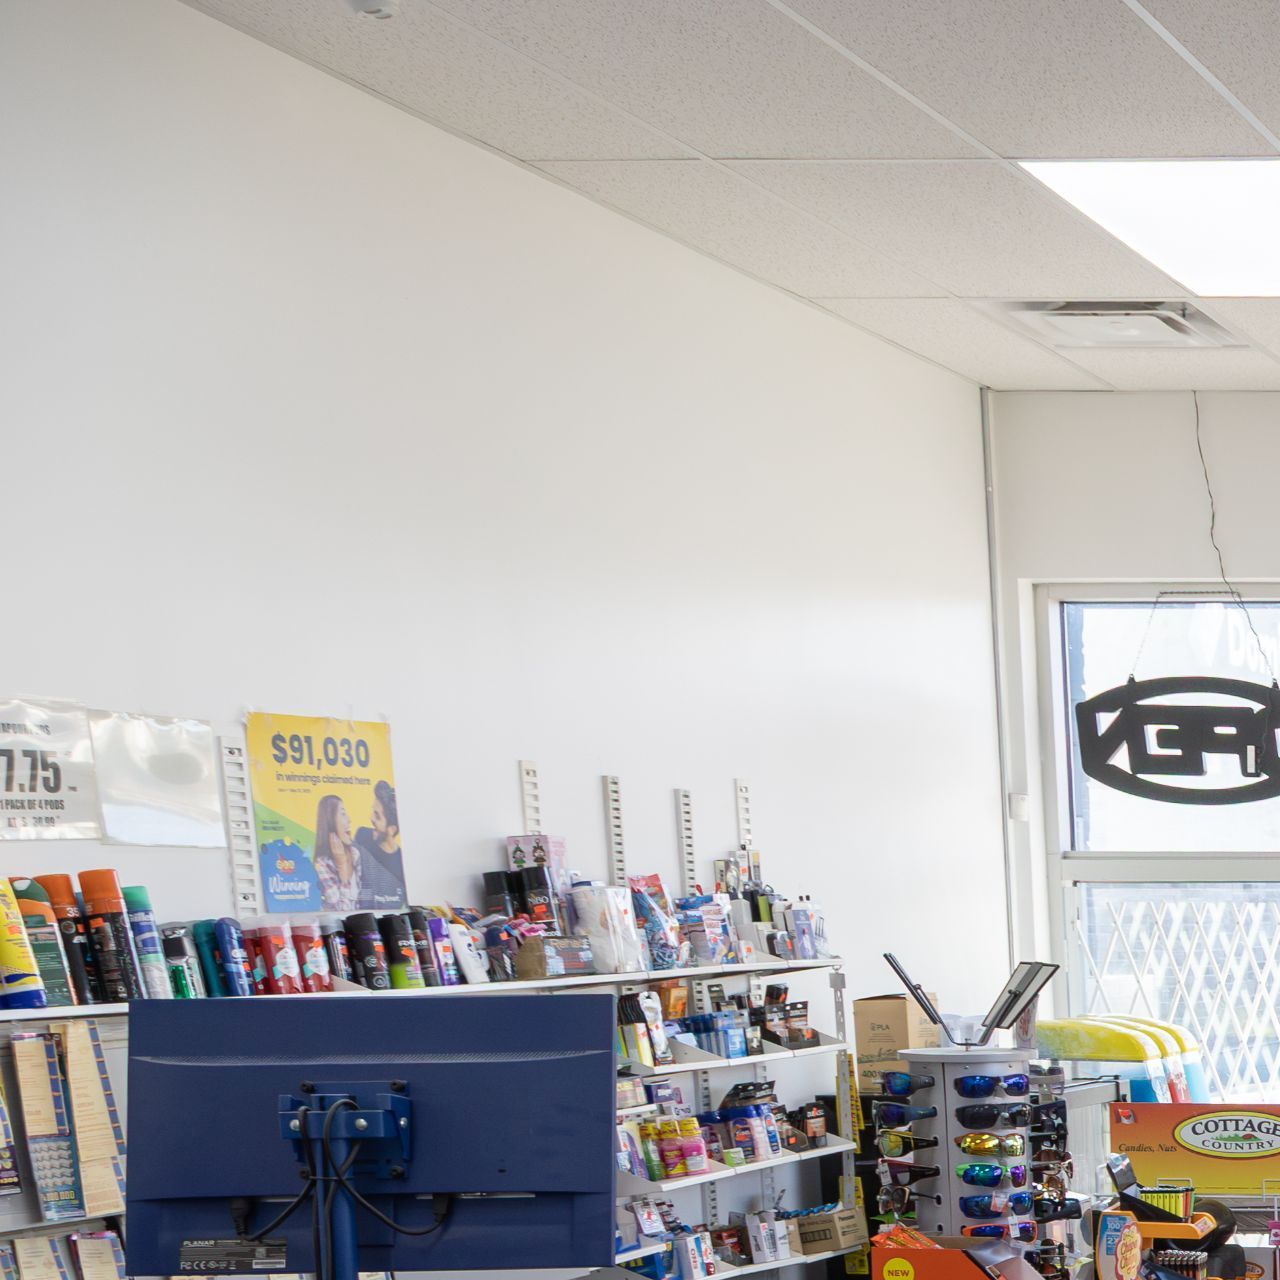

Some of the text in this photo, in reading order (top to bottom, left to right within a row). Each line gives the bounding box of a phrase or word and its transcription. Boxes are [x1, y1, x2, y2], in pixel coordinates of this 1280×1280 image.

[272, 730, 370, 771] $91,030
[275, 771, 371, 786] in winnings claimed here
[1118, 1143, 1178, 1153] Candies, Nuts
[1201, 1139, 1275, 1151] COUNTRY
[887, 1269, 910, 1278] NEW
